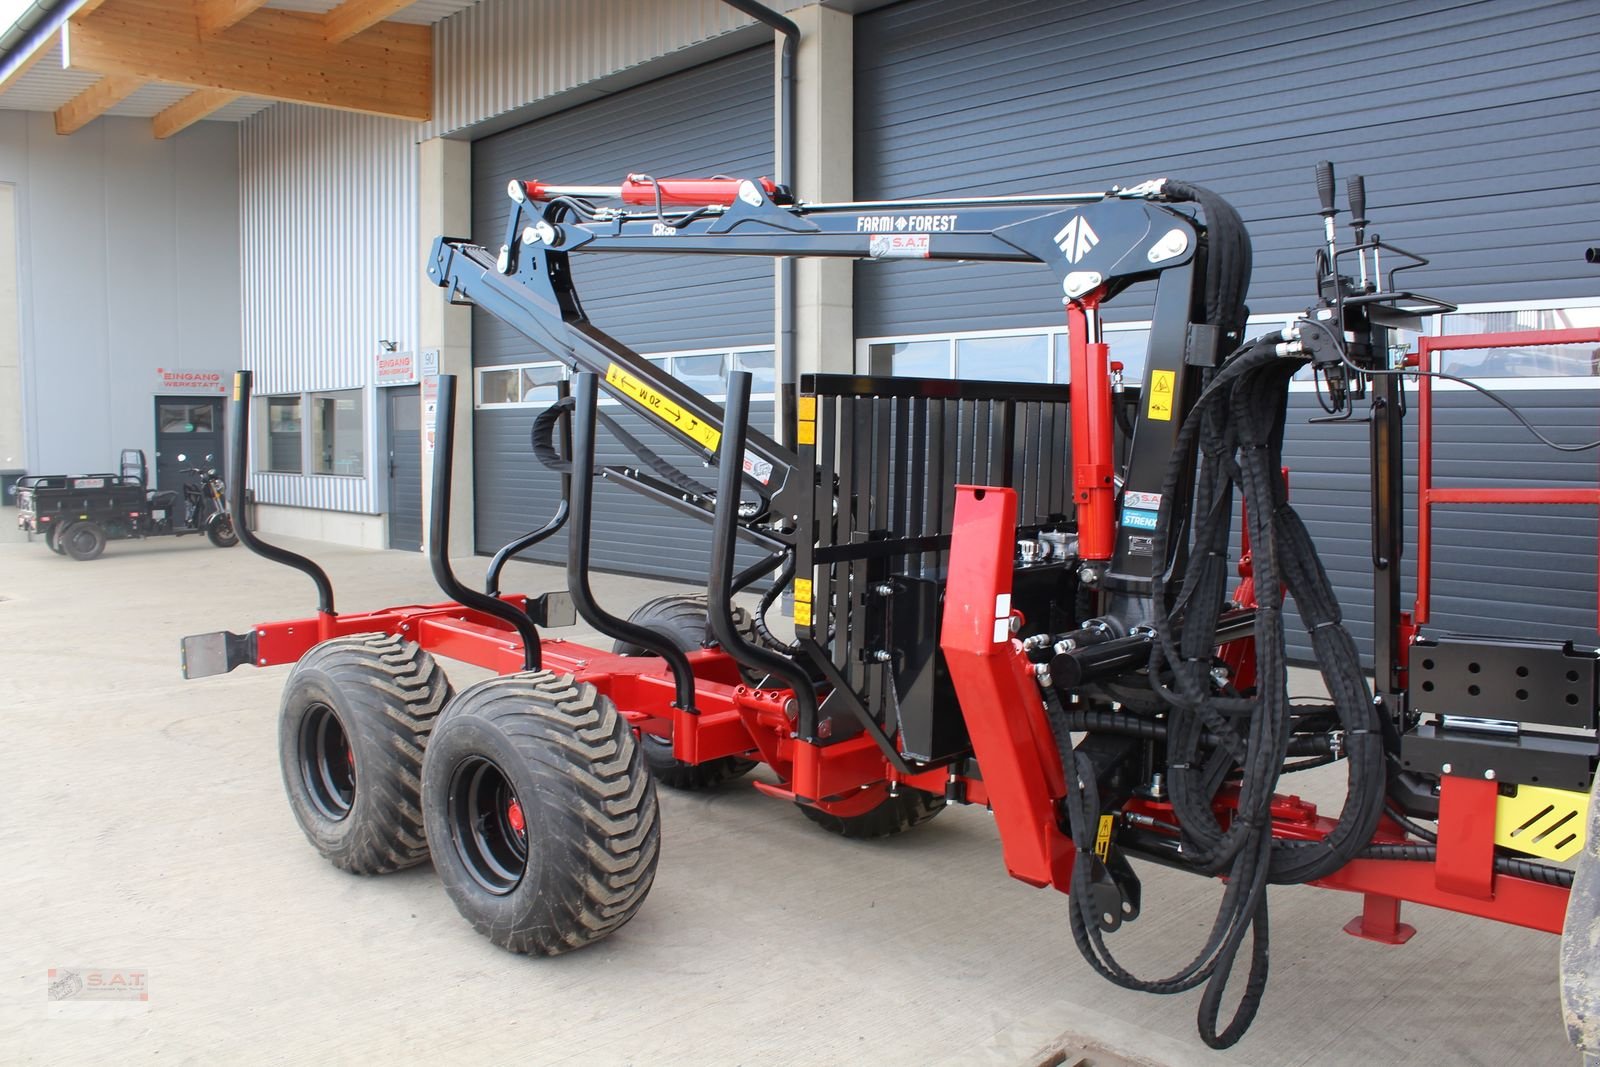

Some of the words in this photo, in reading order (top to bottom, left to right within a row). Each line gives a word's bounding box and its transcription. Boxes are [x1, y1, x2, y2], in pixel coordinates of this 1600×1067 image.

[857, 215, 895, 232] FARMI
[908, 214, 958, 232] FOREST
[379, 357, 410, 368] EINGANG
[638, 388, 648, 400] M
[649, 394, 661, 409] 20
